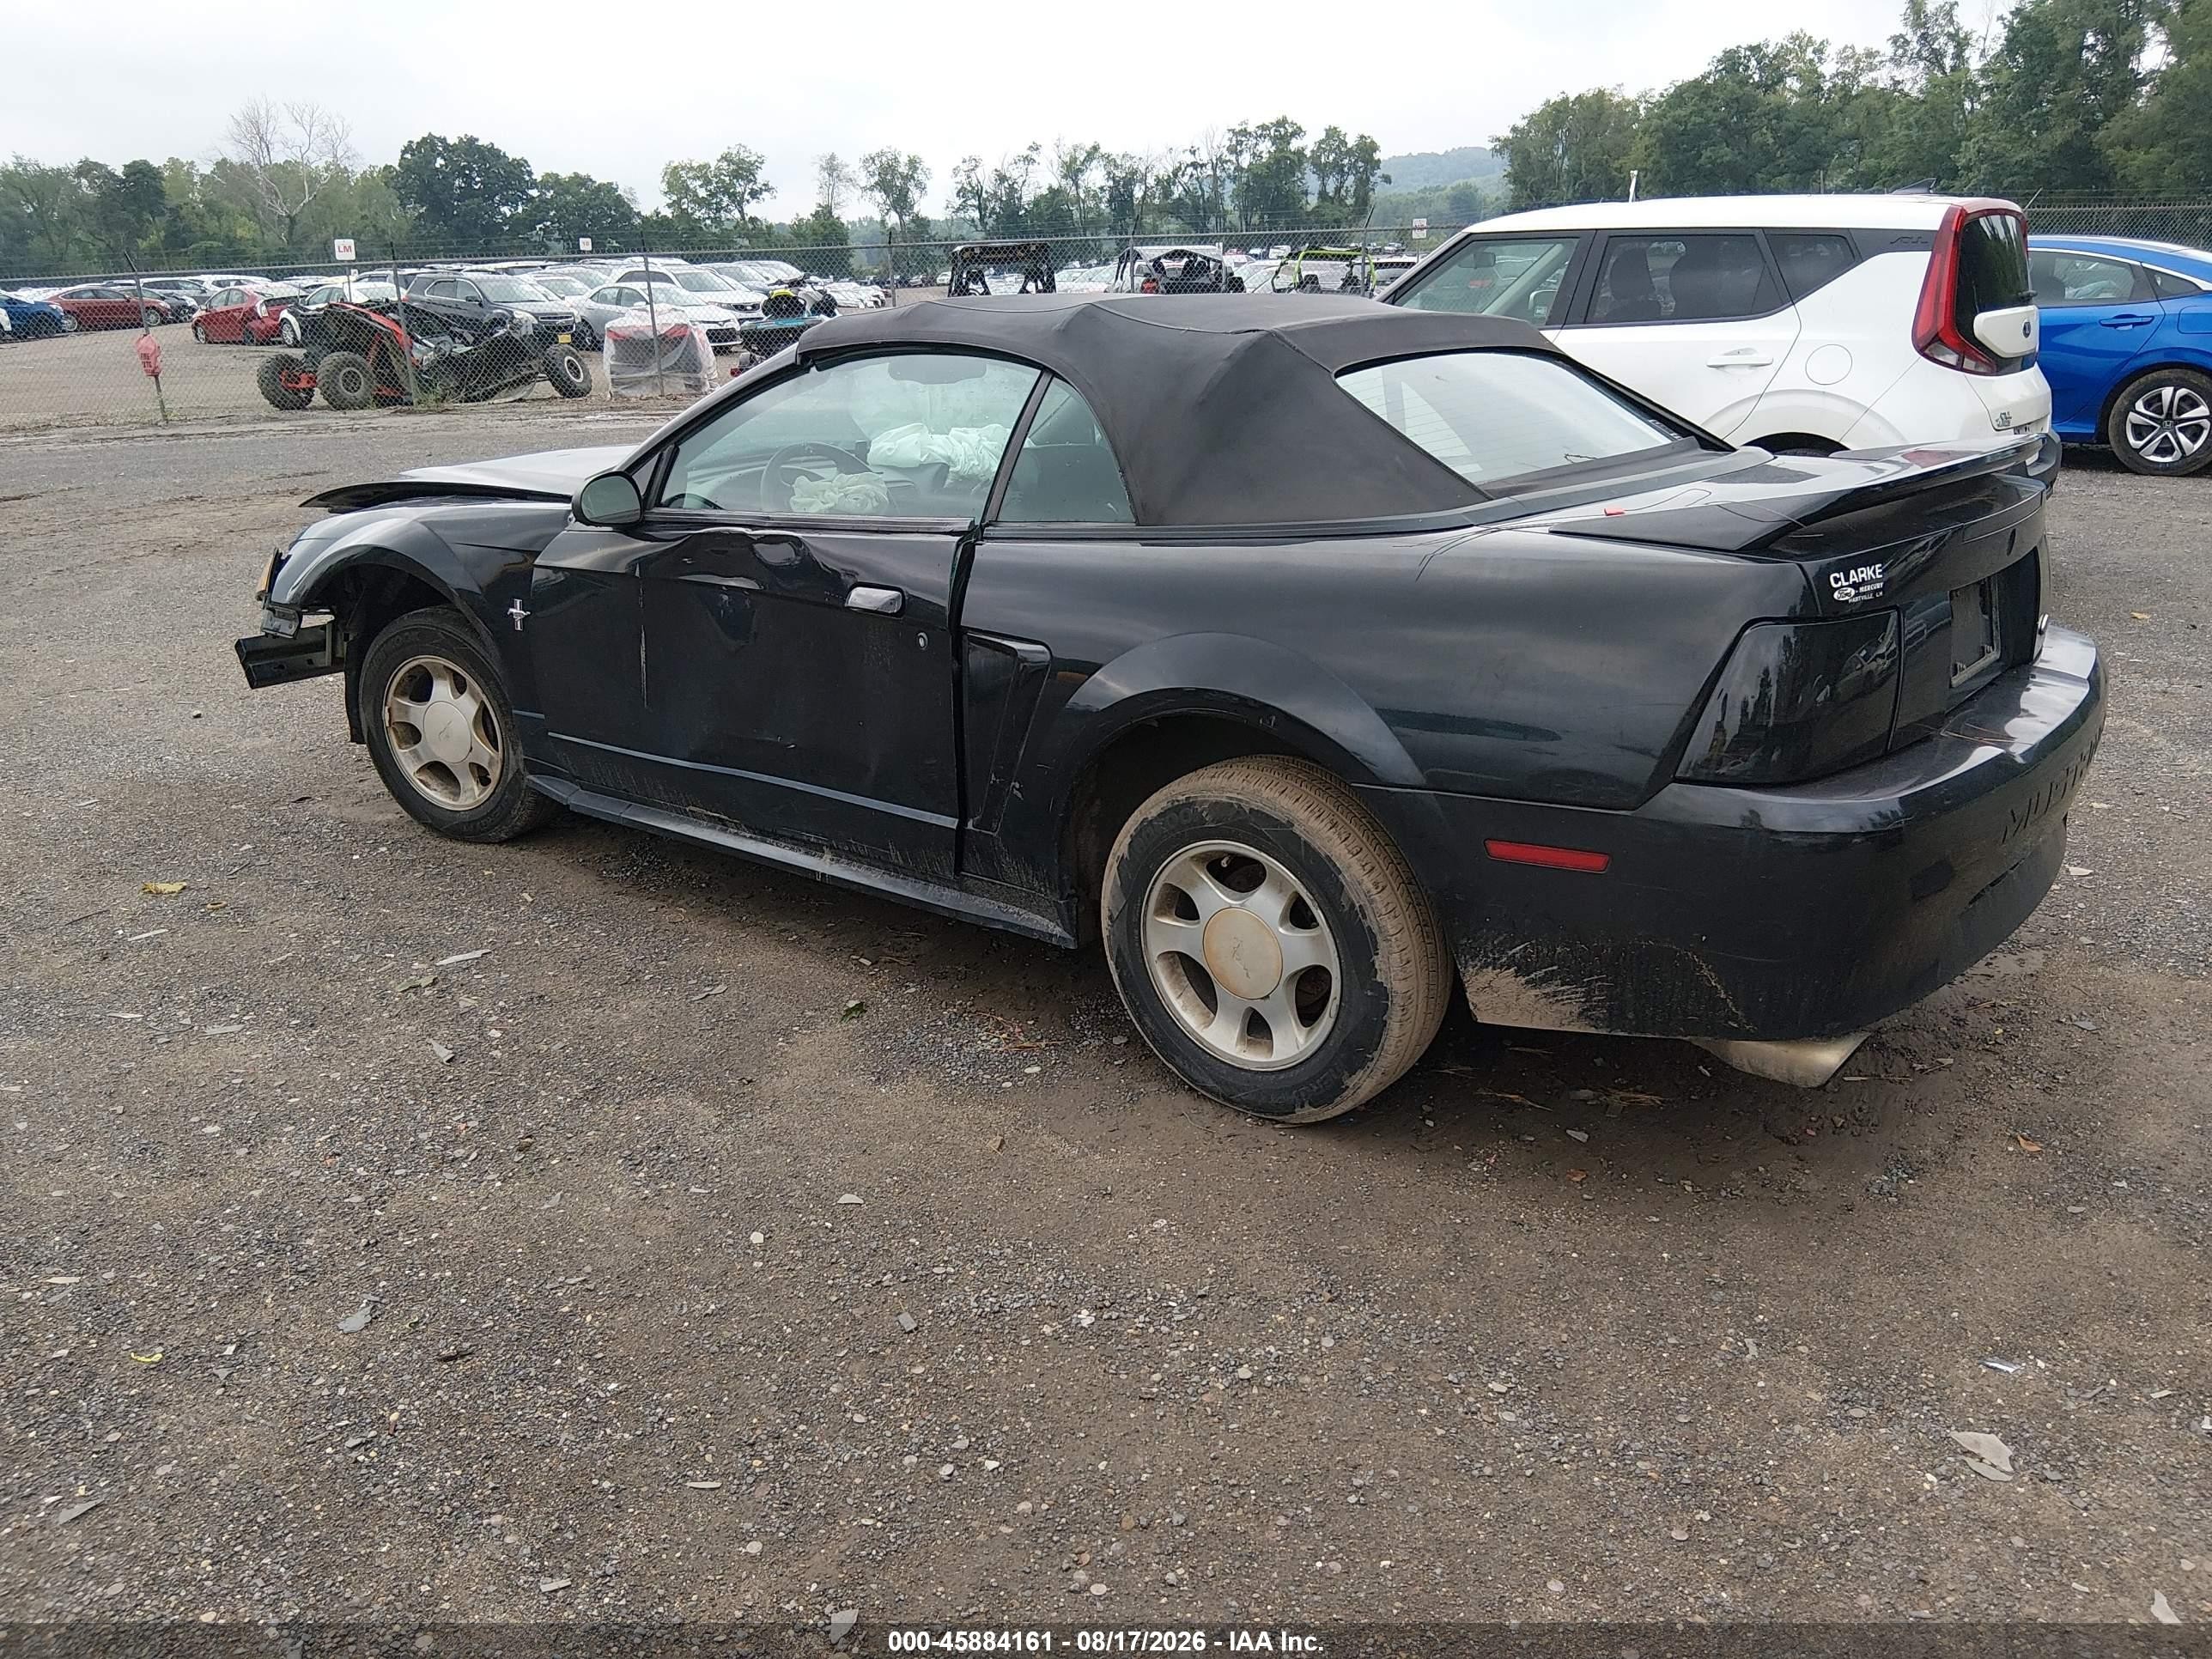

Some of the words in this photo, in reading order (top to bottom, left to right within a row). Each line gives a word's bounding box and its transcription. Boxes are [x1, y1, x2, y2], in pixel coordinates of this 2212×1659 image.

[337, 245, 352, 253] LM
[1829, 563, 1883, 588] CLARKE
[1835, 588, 1853, 599] Ford
